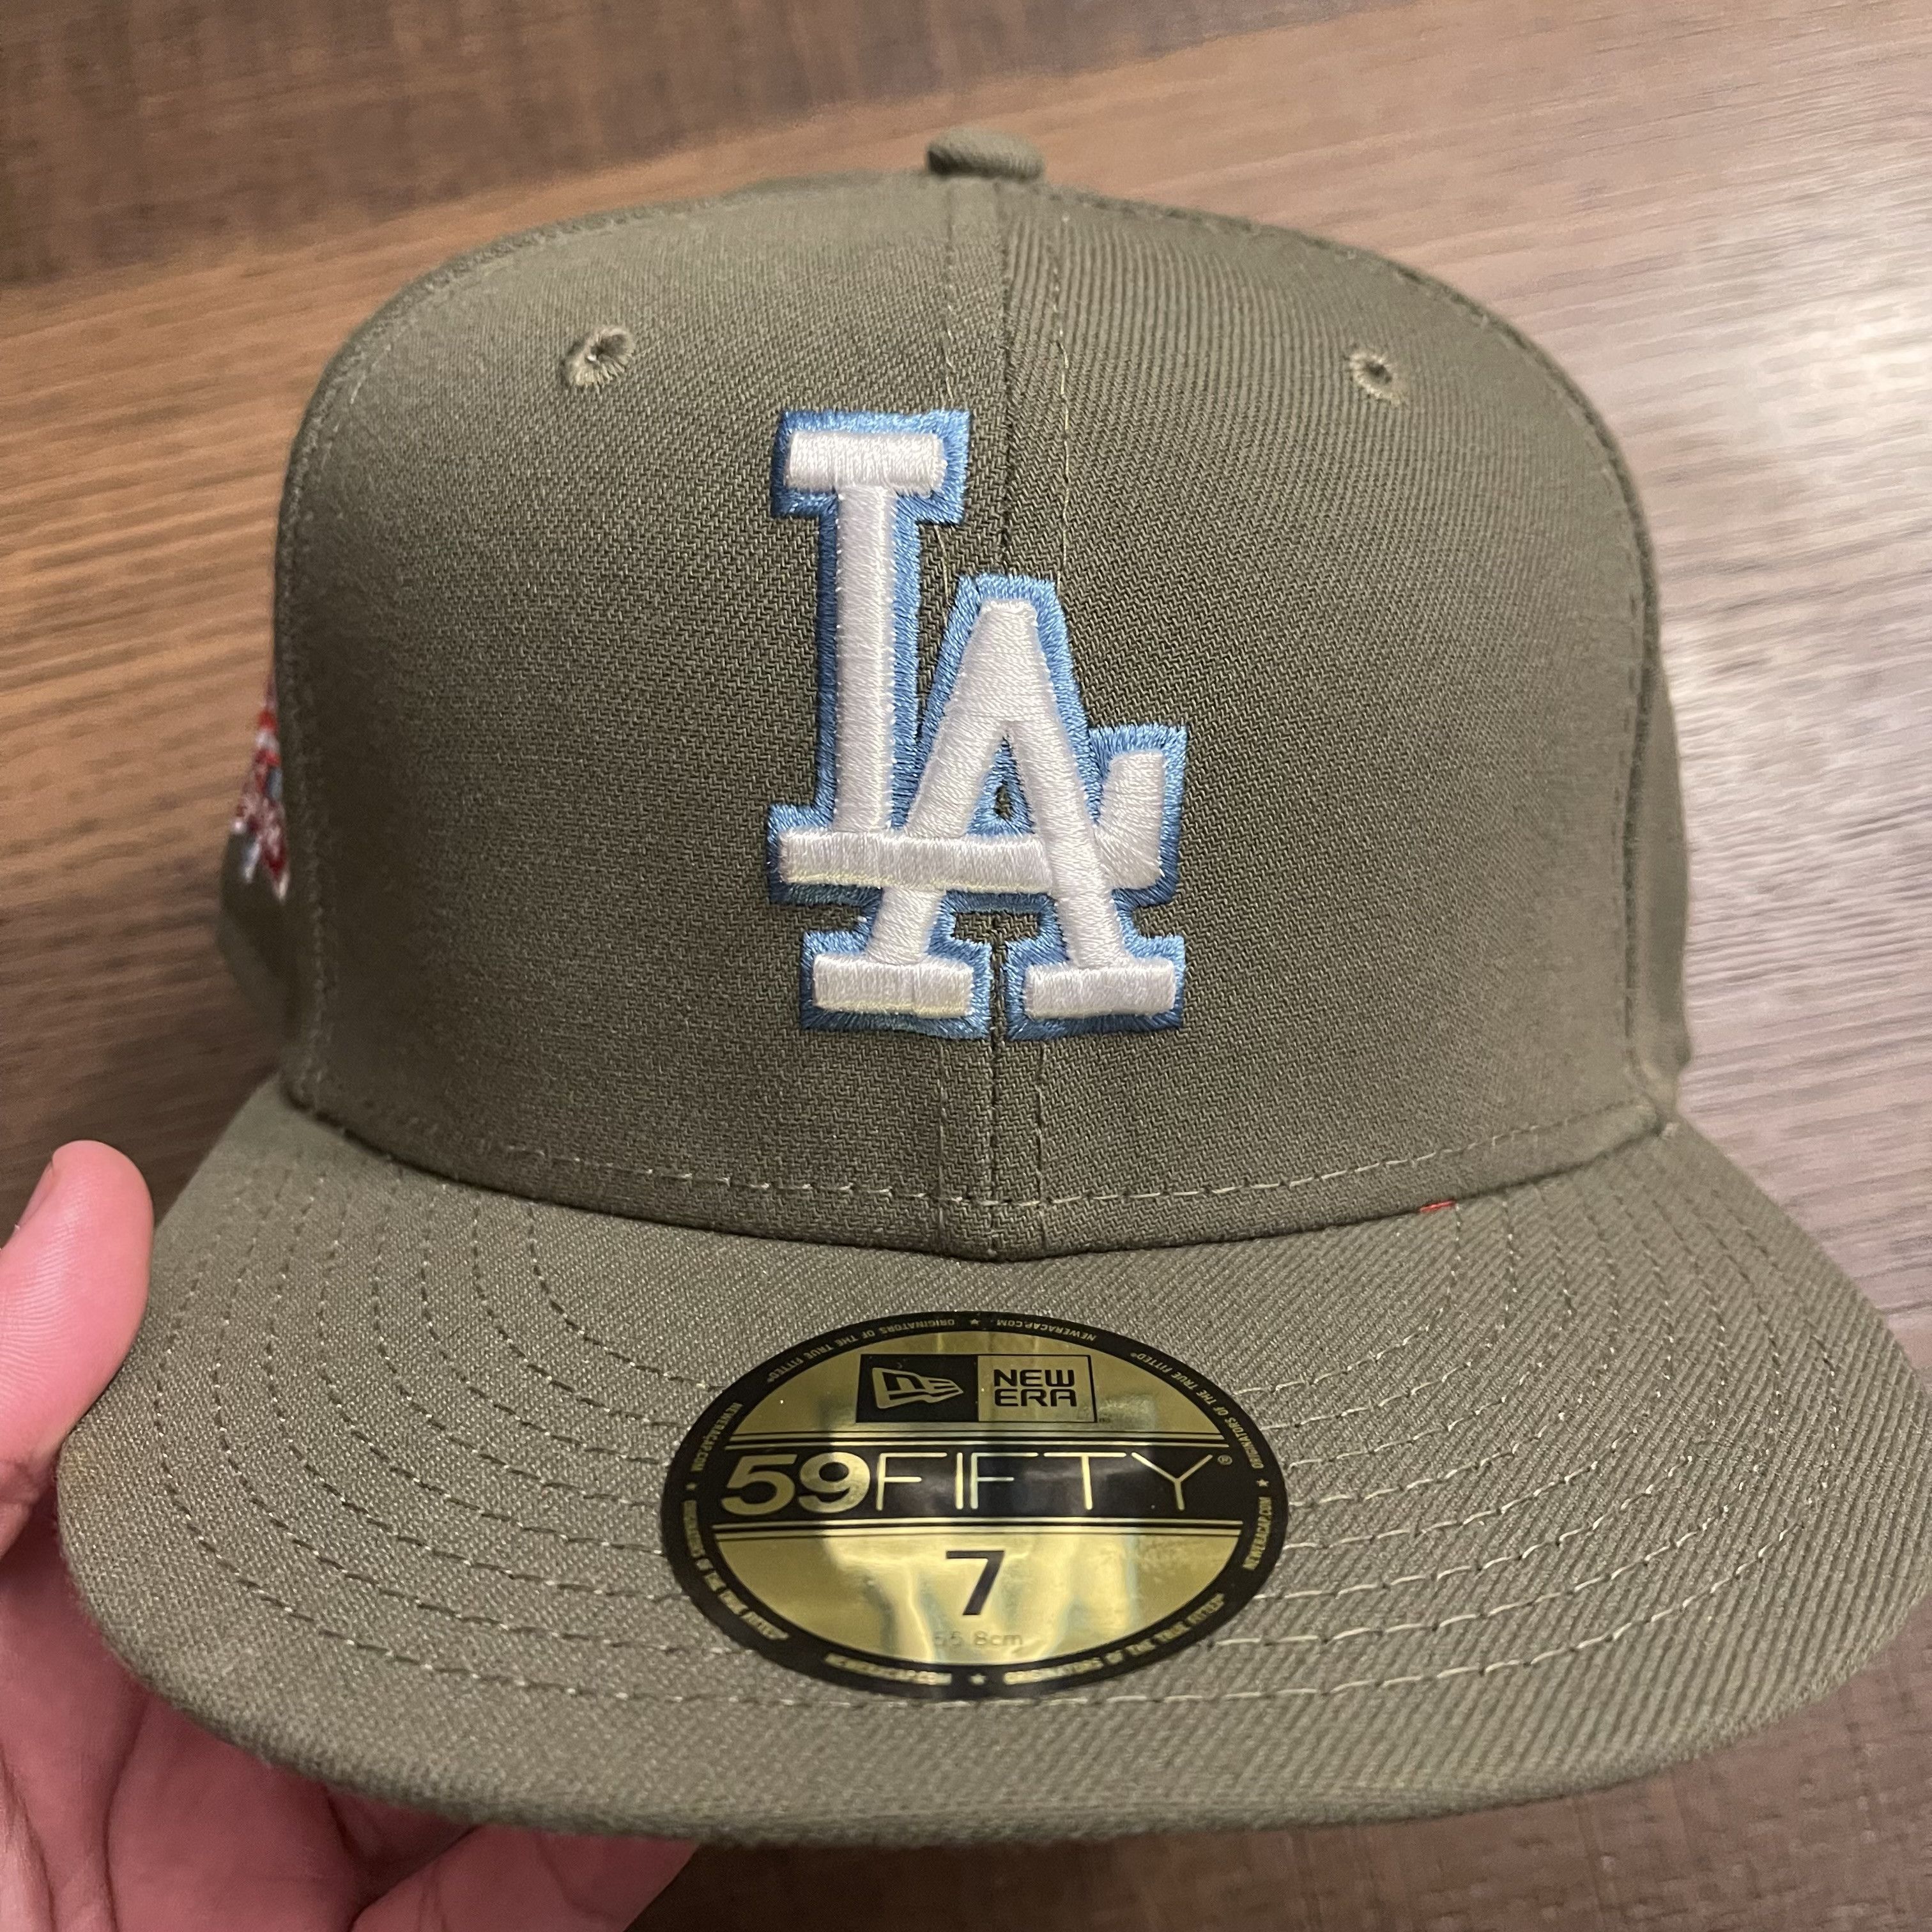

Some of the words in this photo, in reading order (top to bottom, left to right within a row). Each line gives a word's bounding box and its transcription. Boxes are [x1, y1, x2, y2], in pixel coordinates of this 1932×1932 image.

[768, 410, 1187, 1039] LA
[862, 1330, 876, 1339] OF
[878, 1318, 955, 1335] ORIGINATORS
[996, 1318, 1098, 1342] NEWERACAP.COM
[836, 1335, 859, 1348] THE
[802, 1344, 833, 1360] TRUE
[993, 1368, 1075, 1388] NEW
[1170, 1371, 1199, 1390] TRUE
[993, 1388, 1077, 1407] ERA
[1195, 1389, 1216, 1405] THE
[1213, 1406, 1229, 1416] OF
[946, 1550, 1006, 1616] 7
